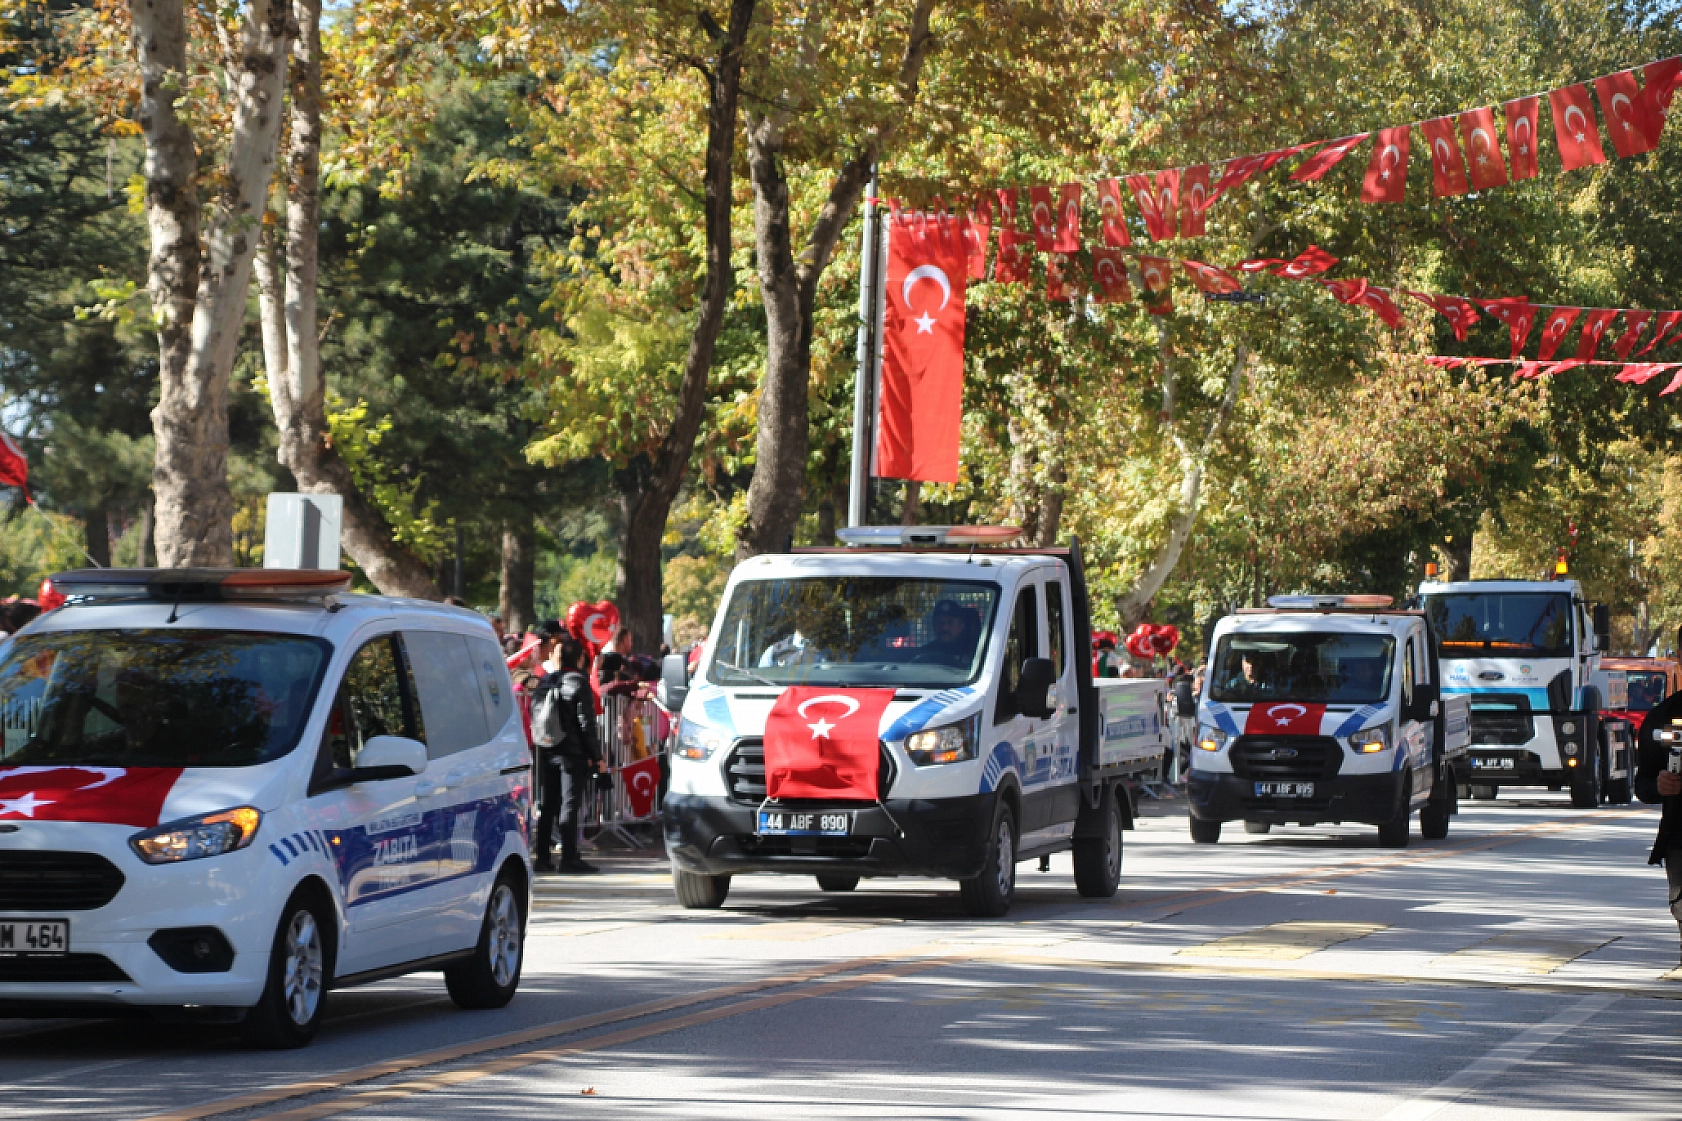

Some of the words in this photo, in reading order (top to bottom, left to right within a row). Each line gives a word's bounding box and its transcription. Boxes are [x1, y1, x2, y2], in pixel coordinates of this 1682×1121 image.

[767, 813, 783, 830] 44
[790, 814, 814, 830] ABF
[820, 814, 845, 831] 890
[372, 834, 418, 867] ZABITA
[26, 924, 63, 949] 464
